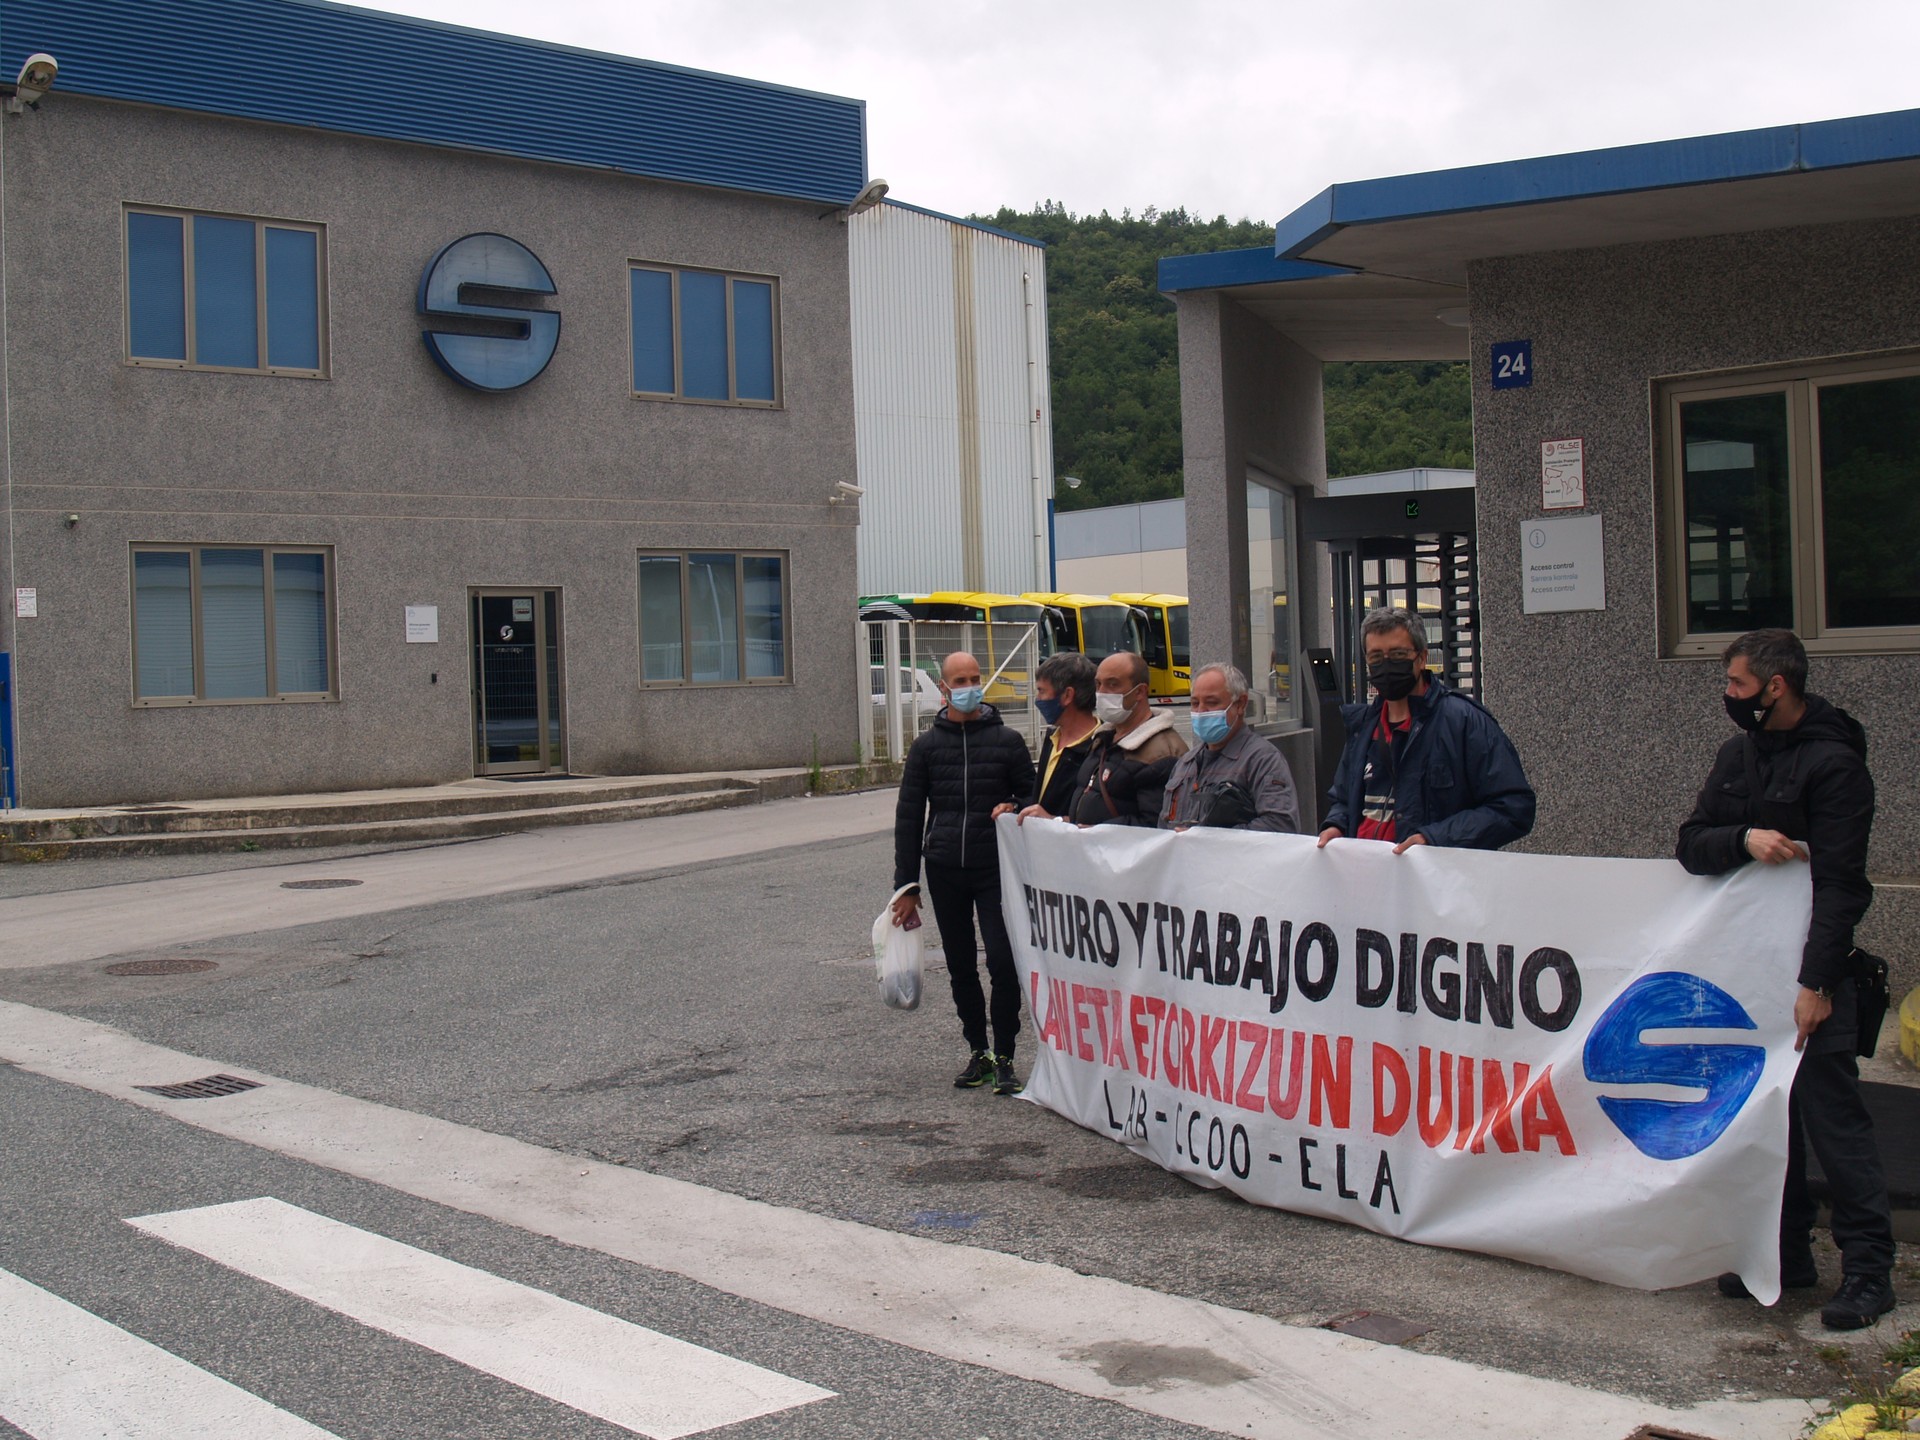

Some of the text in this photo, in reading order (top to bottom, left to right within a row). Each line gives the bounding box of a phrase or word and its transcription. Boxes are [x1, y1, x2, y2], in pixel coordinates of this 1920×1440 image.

[1498, 353, 1526, 378] 24
[1553, 562, 1575, 570] control
[1554, 584, 1576, 592] control
[1024, 884, 1582, 1032] FUTURO Y TRABAJO DIGNO
[1031, 971, 1578, 1156] LAN ETA ETORKIZUN DUINA
[1104, 1079, 1148, 1141] LAB
[1176, 1102, 1251, 1180] CCOO
[1300, 1137, 1400, 1215] ELA
